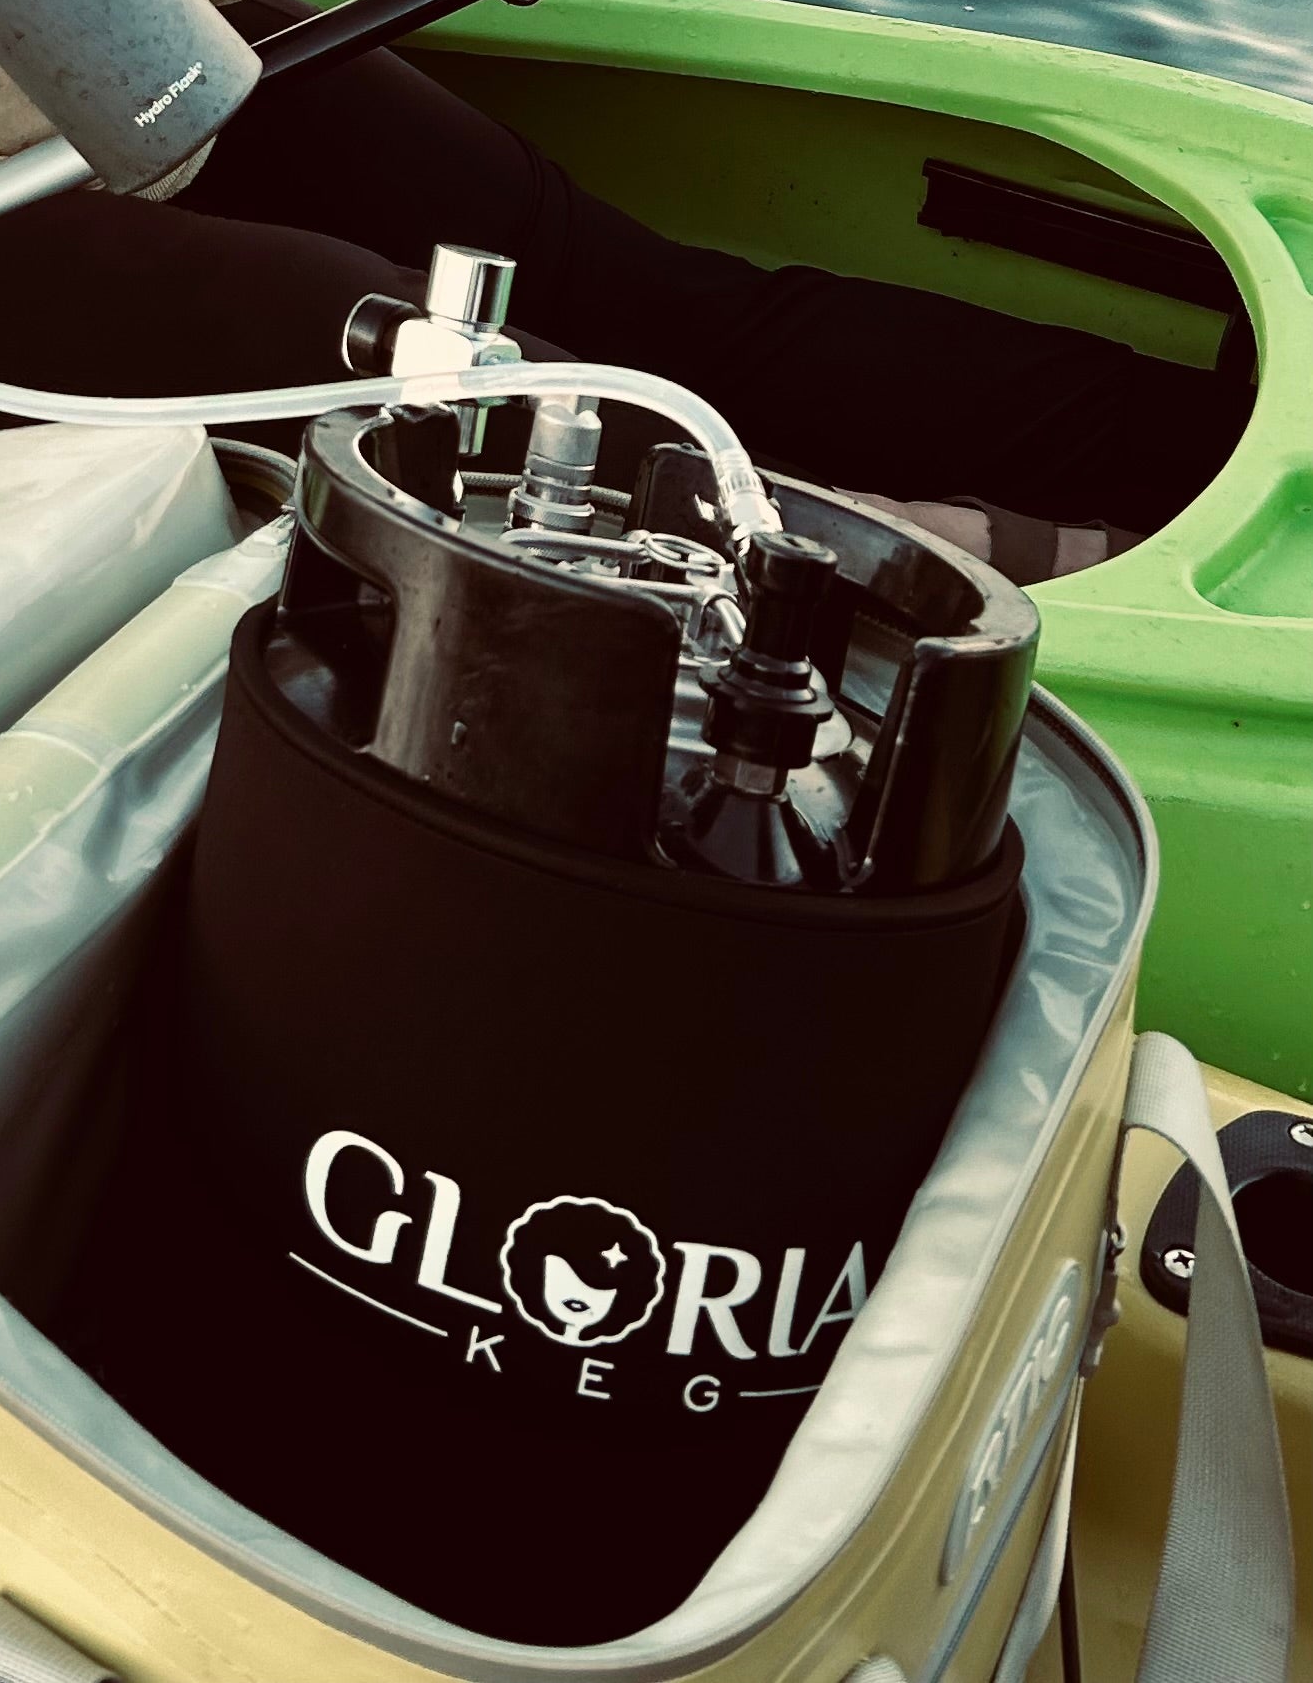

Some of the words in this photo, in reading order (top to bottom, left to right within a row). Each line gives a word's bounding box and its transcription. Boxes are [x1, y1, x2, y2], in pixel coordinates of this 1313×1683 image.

[134, 95, 173, 128] Hydro
[305, 1130, 869, 1360] GLORIA
[465, 1325, 721, 1412] KEG
